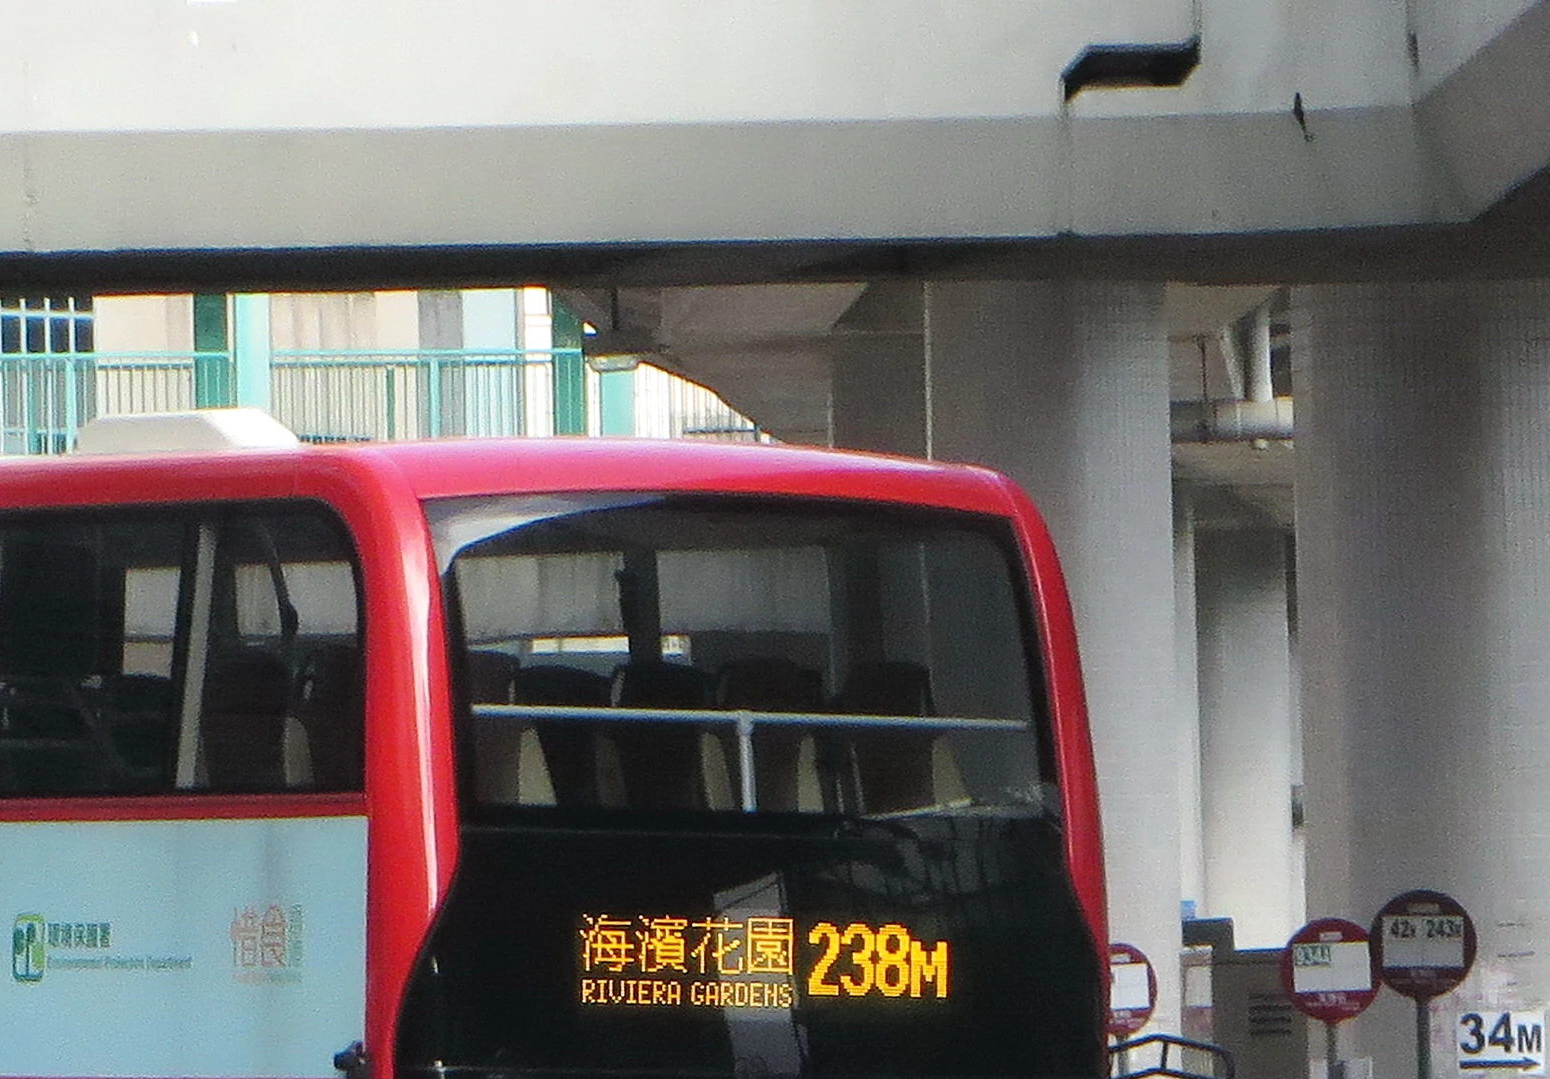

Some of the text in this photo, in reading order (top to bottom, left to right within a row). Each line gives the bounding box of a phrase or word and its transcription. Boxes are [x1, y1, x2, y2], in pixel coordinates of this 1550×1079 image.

[579, 913, 795, 975] 海濱花園
[807, 922, 949, 999] 238M
[581, 979, 794, 1008] RIVIERA GARDENS
[1459, 1011, 1542, 1055] 34M
